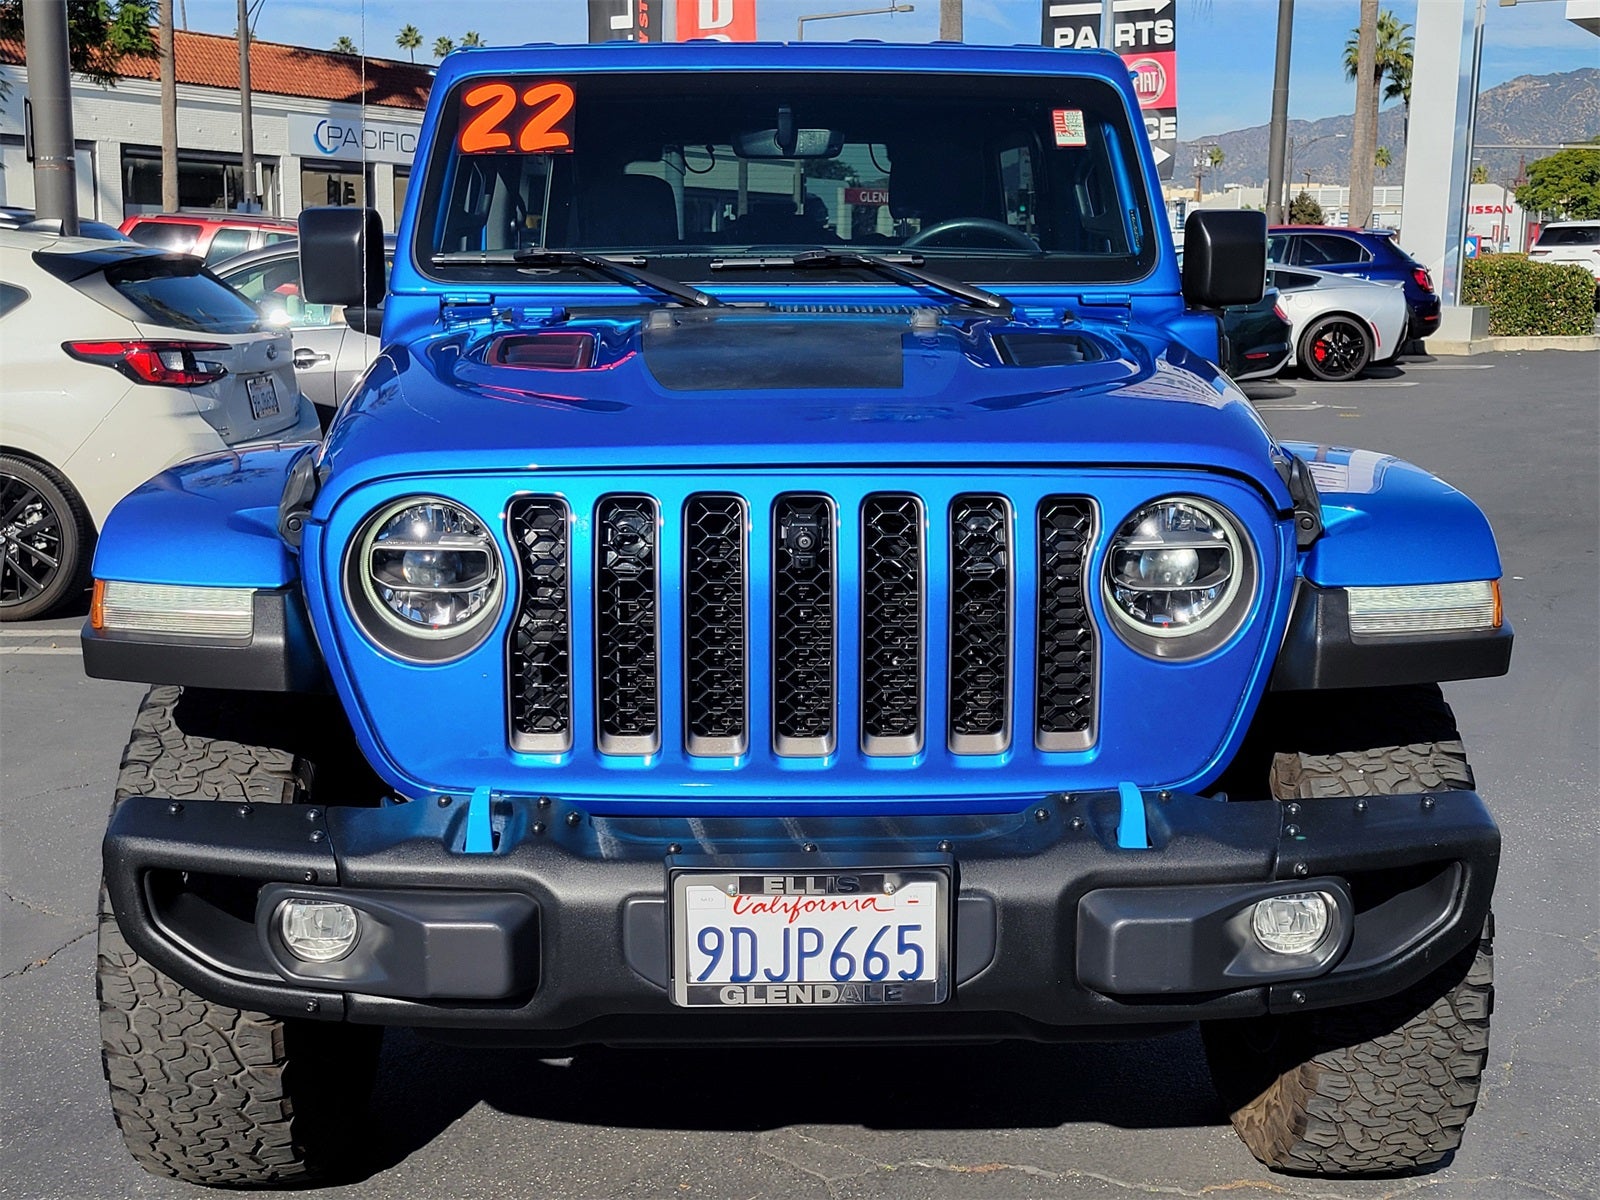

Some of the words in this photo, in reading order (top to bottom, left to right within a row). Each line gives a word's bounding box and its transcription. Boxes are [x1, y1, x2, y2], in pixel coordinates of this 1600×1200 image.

[1054, 19, 1174, 49] PARTS
[461, 83, 575, 152] 22
[327, 125, 416, 153] PACIFIC
[763, 876, 860, 894] ELLIS
[733, 895, 895, 924] California
[697, 924, 924, 982] 9DJP665
[719, 985, 902, 1004] GLENDALE
